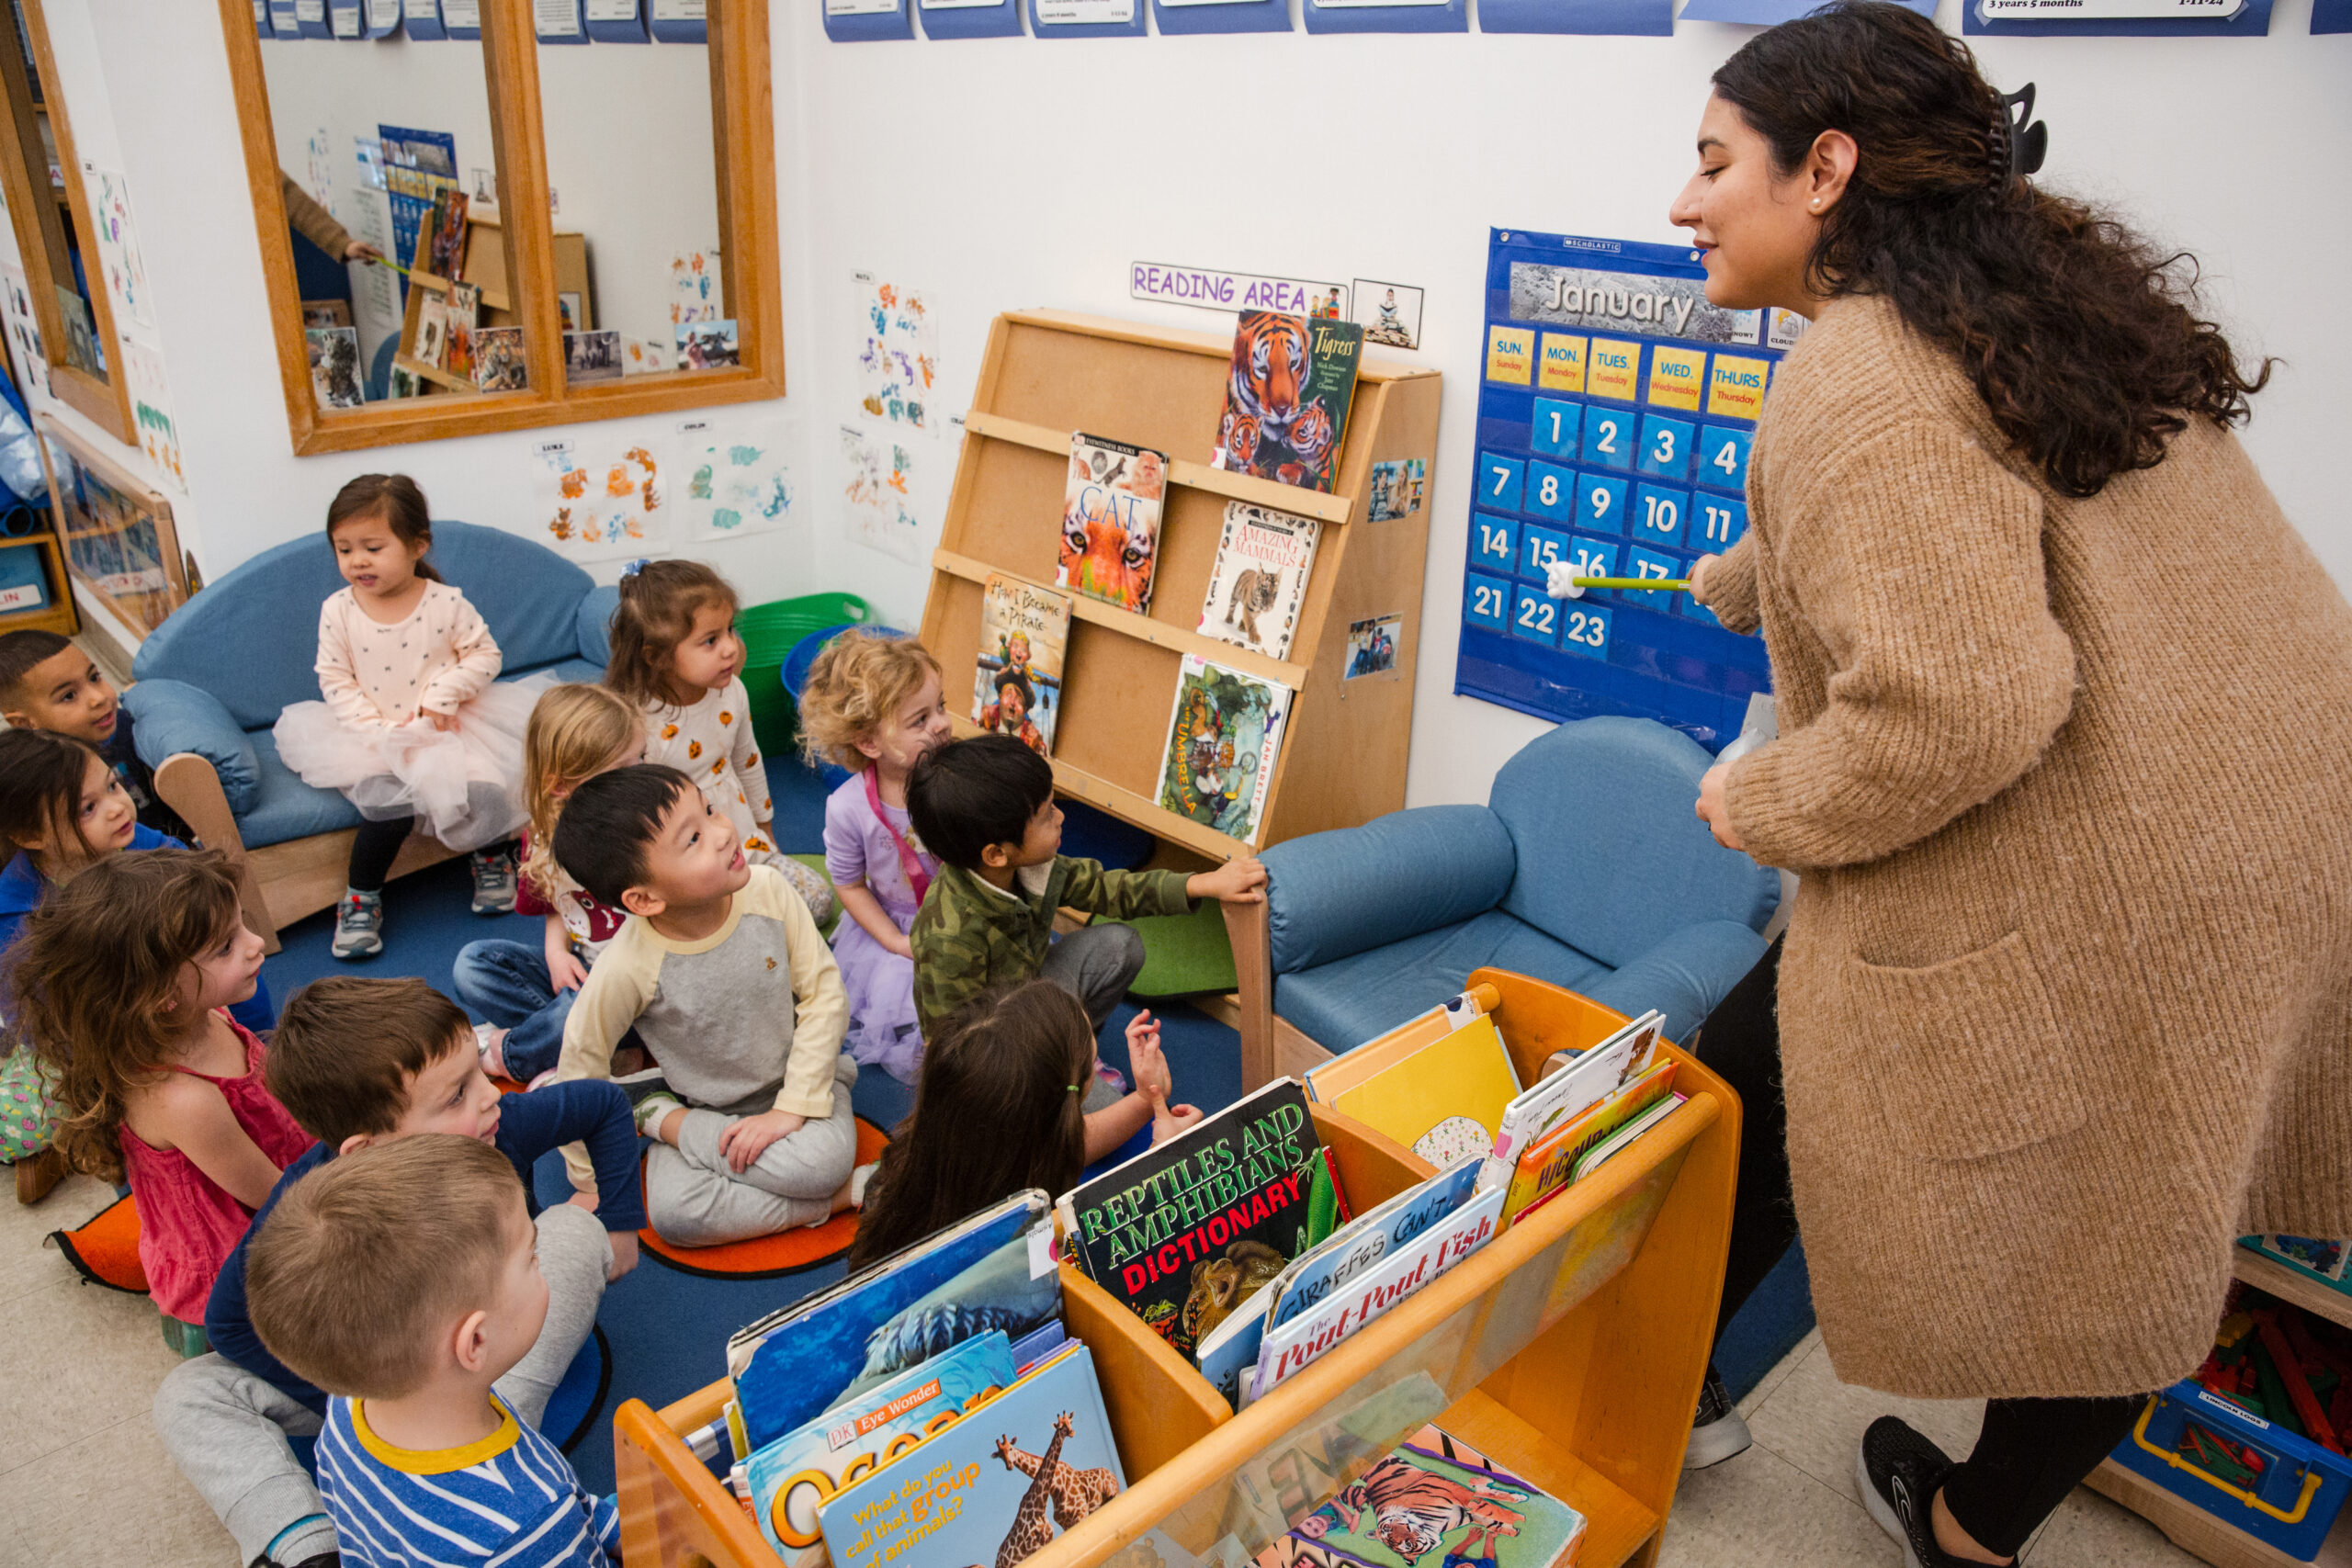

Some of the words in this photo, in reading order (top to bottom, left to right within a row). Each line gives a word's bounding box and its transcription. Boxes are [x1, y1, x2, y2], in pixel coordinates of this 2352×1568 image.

[1988, 0, 1996, 8] 3
[1997, 0, 2028, 9] years
[2030, 0, 2037, 8] 5
[1572, 239, 1620, 251] SCHOLASTIC
[1134, 266, 1235, 303] READING
[1244, 281, 1306, 311] AREA
[1545, 276, 1694, 335] January
[1314, 326, 1356, 361] Tigress
[1496, 340, 1524, 357] SUN.
[1546, 346, 1579, 365] MON.
[1770, 337, 1795, 346] CLOUD
[1496, 358, 1522, 374] Sunday
[1547, 367, 1577, 382] Monday
[1597, 352, 1631, 370] TUES.
[1660, 361, 1694, 379] WED.
[1596, 372, 1628, 388] Tuesday
[1651, 380, 1699, 399] Wednesday
[1714, 369, 1764, 389] THURS.
[1716, 390, 1756, 407] Thursday
[1550, 412, 1562, 444] 1
[1597, 419, 1617, 455] 2
[1653, 430, 1674, 464] 3
[1713, 441, 1737, 476] 4
[1491, 466, 1510, 497] 7
[1539, 474, 1559, 507] 8
[1080, 486, 1142, 531] CAT
[1590, 487, 1611, 519] 9
[1645, 494, 1678, 533] 10
[1238, 525, 1300, 555] AMAZING
[1704, 505, 1732, 543] 11
[1233, 536, 1297, 567] MAMMALS
[1480, 525, 1510, 559] 14
[1530, 536, 1559, 570] 15
[1577, 548, 1607, 579] 16
[1637, 558, 1669, 595] 17
[991, 581, 1011, 601] How
[1014, 589, 1020, 604] I
[1023, 590, 1063, 617] Became
[1474, 586, 1502, 619] 21
[1518, 601, 1555, 637] 22
[1567, 611, 1605, 648] 23
[1264, 739, 1272, 761] JAN
[1176, 722, 1198, 816] UMBRELLA
[1254, 765, 1267, 803] BRETT
[1079, 1137, 1235, 1245] REPTILES
[1242, 1102, 1304, 1160] AND
[1108, 1134, 1304, 1270] AMPHIBIANS
[1122, 1172, 1301, 1296] DICTIONARY
[1280, 1235, 1385, 1325] GIRAFFES
[1393, 1196, 1447, 1244] CAN'T
[1272, 1253, 1430, 1384] Pout-Pout
[1435, 1214, 1492, 1269] Fish
[1308, 1316, 1331, 1337] The
[861, 1410, 886, 1431] Eye
[888, 1382, 937, 1416] Wonder
[2206, 1395, 2238, 1414] LINCOLN
[2240, 1412, 2261, 1425] LOGS
[831, 1422, 854, 1446] DK
[852, 1489, 899, 1526] What
[900, 1479, 922, 1498] do
[923, 1460, 953, 1488] you
[845, 1529, 874, 1559] call
[874, 1508, 909, 1540] that
[910, 1462, 980, 1523] group
[885, 1496, 963, 1562] animals?
